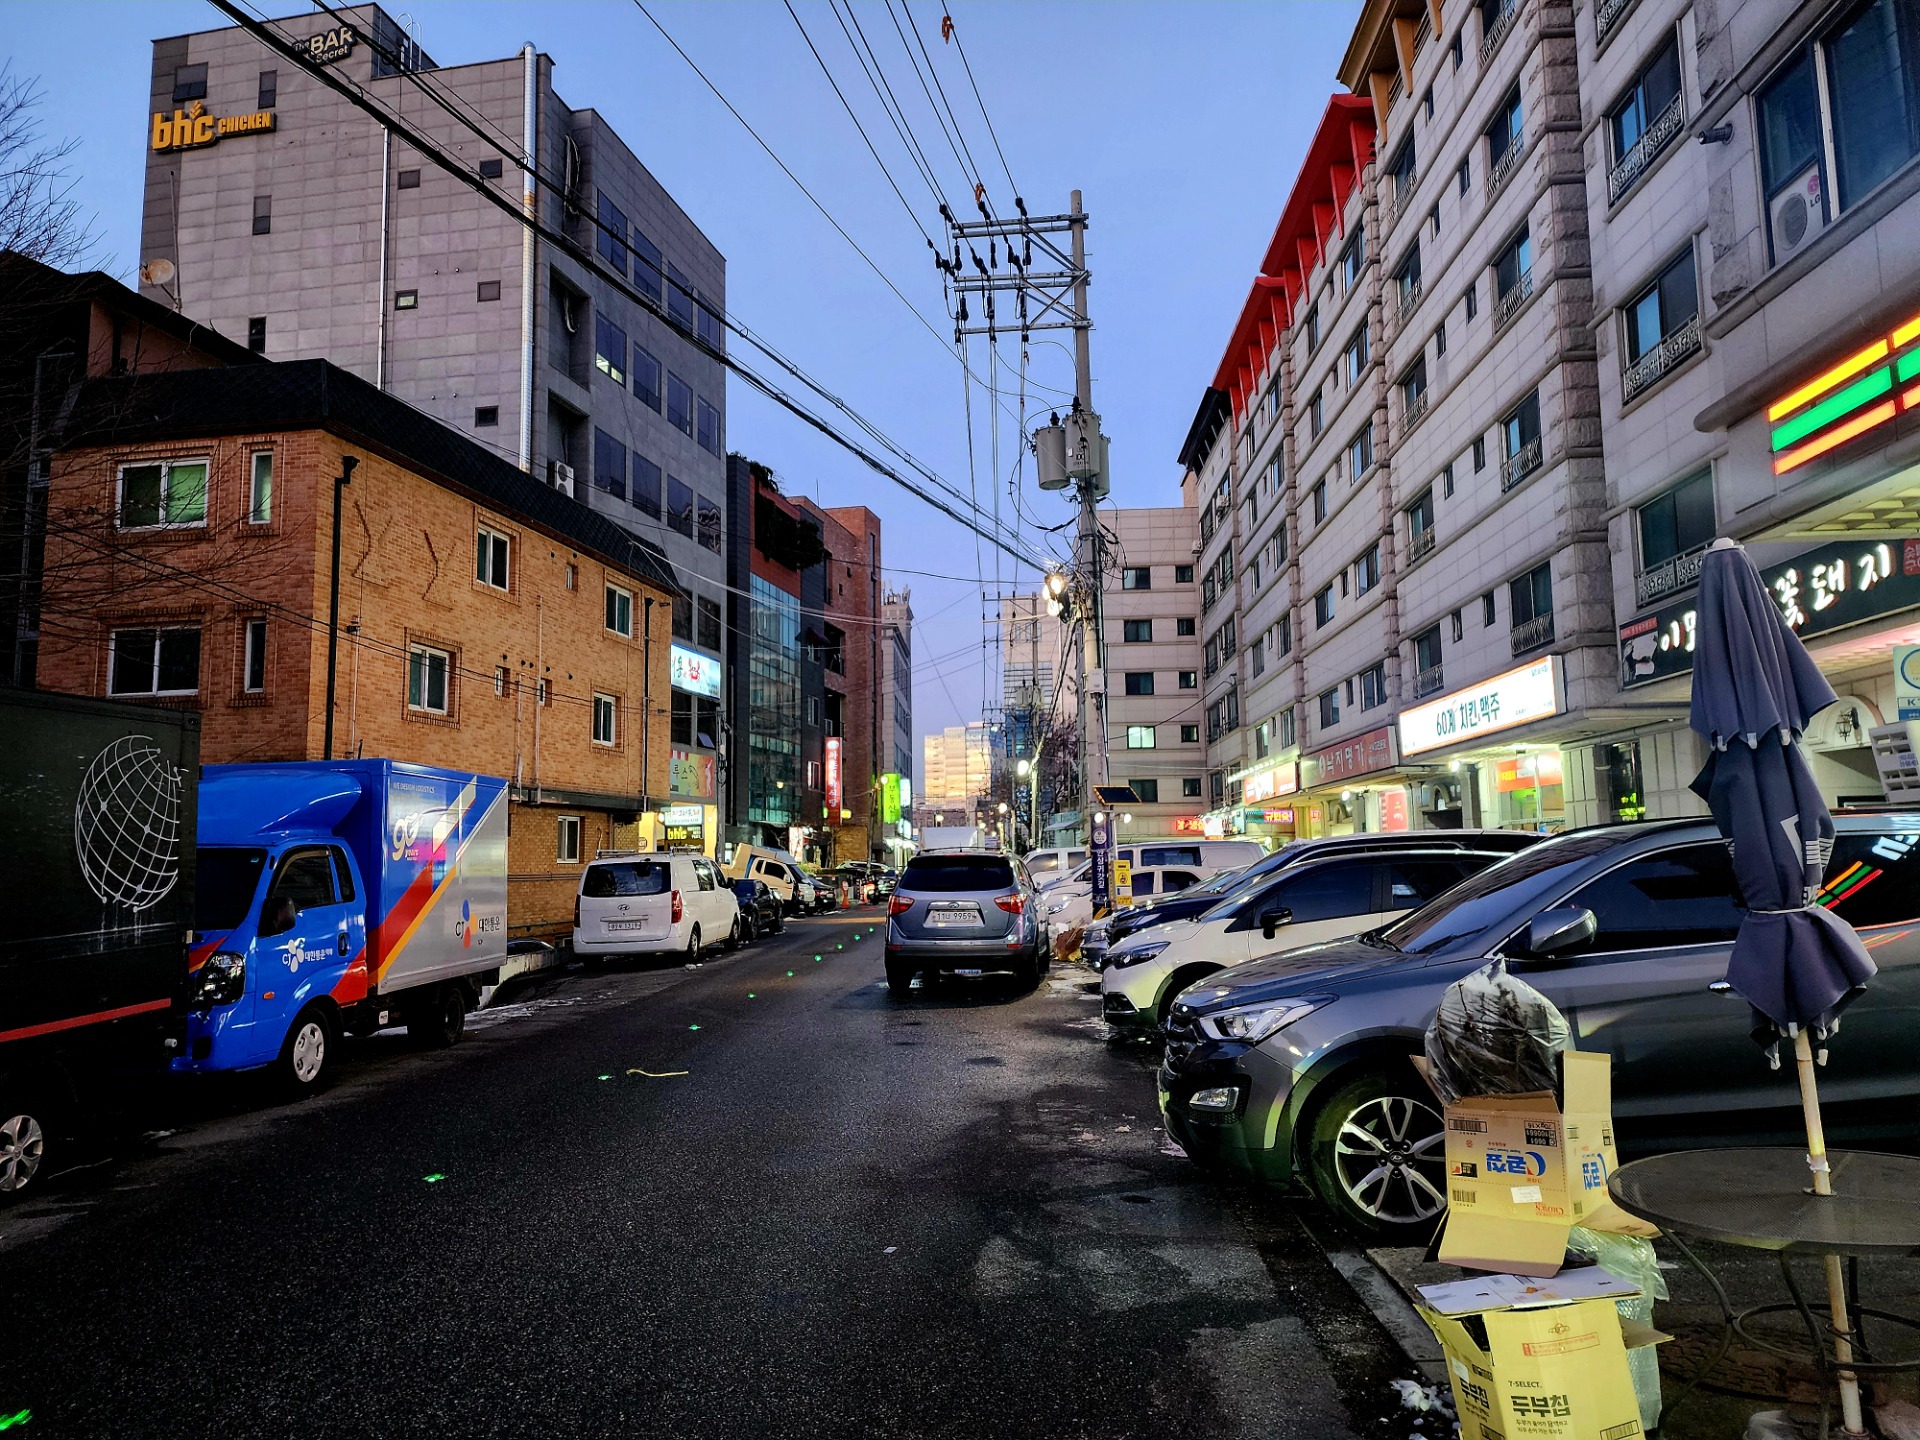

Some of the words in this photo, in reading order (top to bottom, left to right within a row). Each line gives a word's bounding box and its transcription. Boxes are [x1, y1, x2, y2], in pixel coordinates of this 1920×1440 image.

[310, 27, 353, 55] BAR
[316, 45, 348, 62] Secret
[152, 111, 215, 150] bhc
[217, 112, 272, 134] CHICKEN
[1327, 741, 1365, 776] 낙지명가
[416, 784, 435, 794] LOGISTICS
[667, 826, 687, 840] bhc
[455, 921, 464, 939] CJ
[479, 916, 500, 932] 대한통운
[282, 953, 291, 967] CJ
[1511, 1394, 1571, 1418] 두부칩
